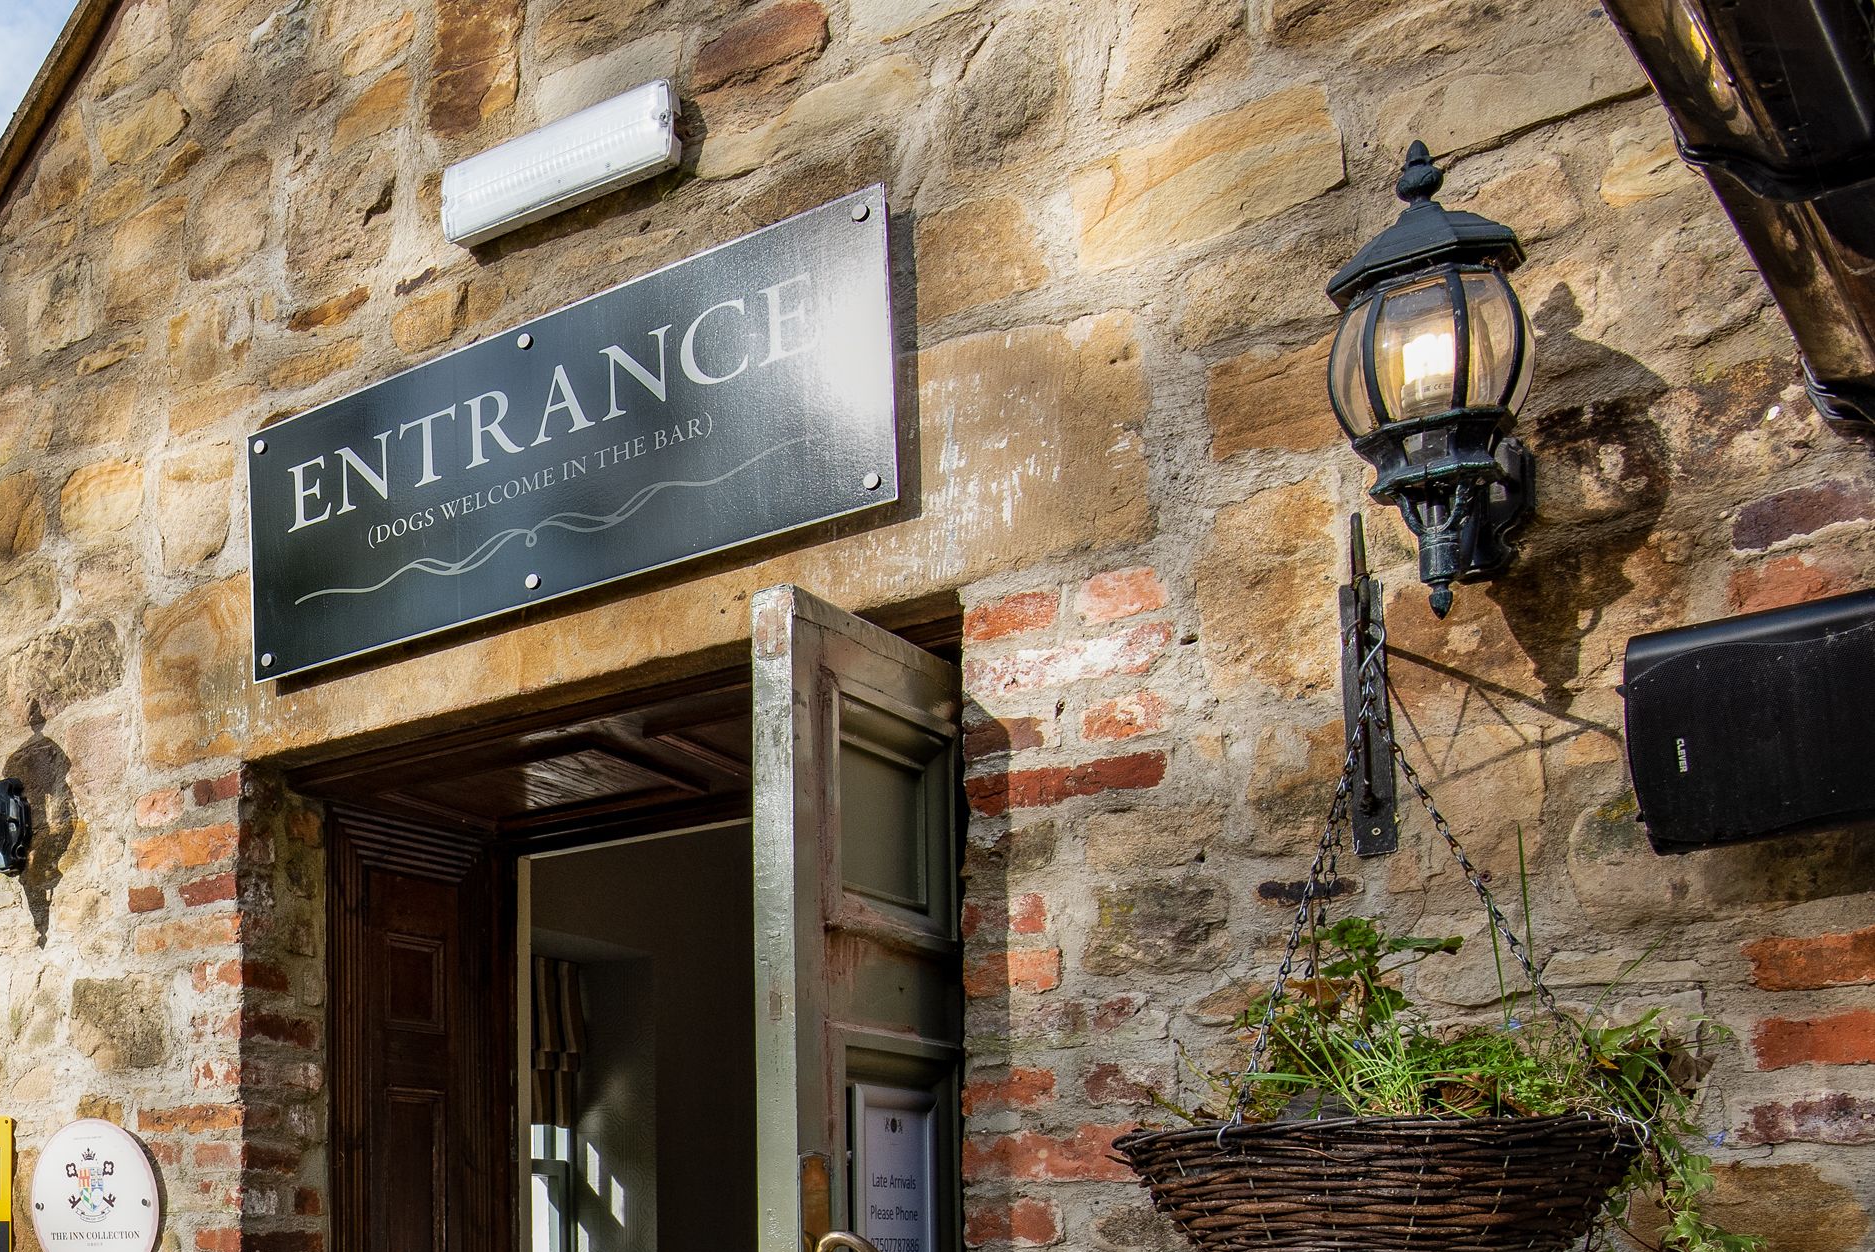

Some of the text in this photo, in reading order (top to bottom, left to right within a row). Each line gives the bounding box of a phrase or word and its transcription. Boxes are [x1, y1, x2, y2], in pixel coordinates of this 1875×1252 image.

[287, 272, 819, 534] ENTRANCE
[368, 412, 713, 549] (DOGS WELCOME IN THE BAR)
[1676, 738, 1689, 773] CLEVER
[872, 1172, 916, 1190] Late Arrivals
[870, 1204, 918, 1221] Please Phone
[51, 1230, 140, 1240] THE INN COLLECTION
